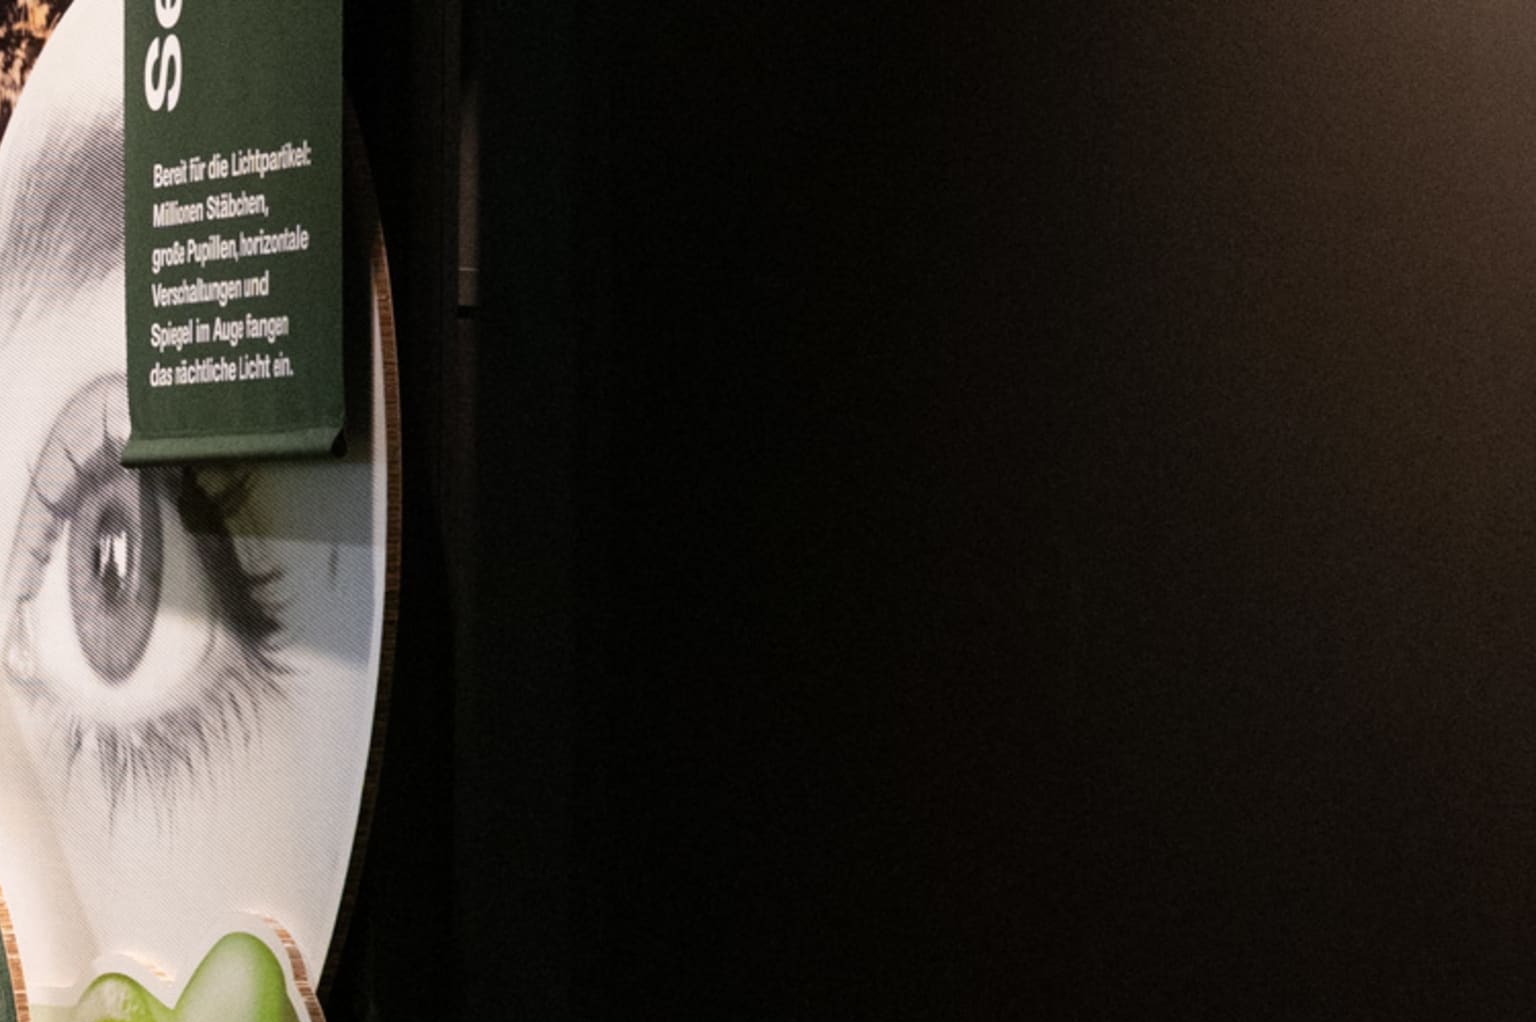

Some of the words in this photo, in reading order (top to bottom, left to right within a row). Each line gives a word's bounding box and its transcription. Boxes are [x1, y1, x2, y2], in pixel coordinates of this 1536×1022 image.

[153, 162, 187, 188] Bereit
[189, 156, 207, 182] für
[208, 152, 229, 180] die
[153, 199, 204, 228] Millionen
[206, 190, 270, 220] Stäbchen,
[151, 241, 185, 274] große
[186, 234, 239, 268] Pupillen,
[239, 223, 310, 257] horizontale
[151, 277, 242, 308] Verschaltungen
[243, 268, 270, 298] und
[150, 318, 194, 353] Spiegel
[195, 317, 211, 344] im
[212, 316, 245, 347] Auge
[245, 312, 290, 344] fangen
[149, 361, 173, 388] das
[174, 356, 237, 386] nächtliche
[238, 353, 271, 381] Licht
[272, 351, 295, 378] ein.
